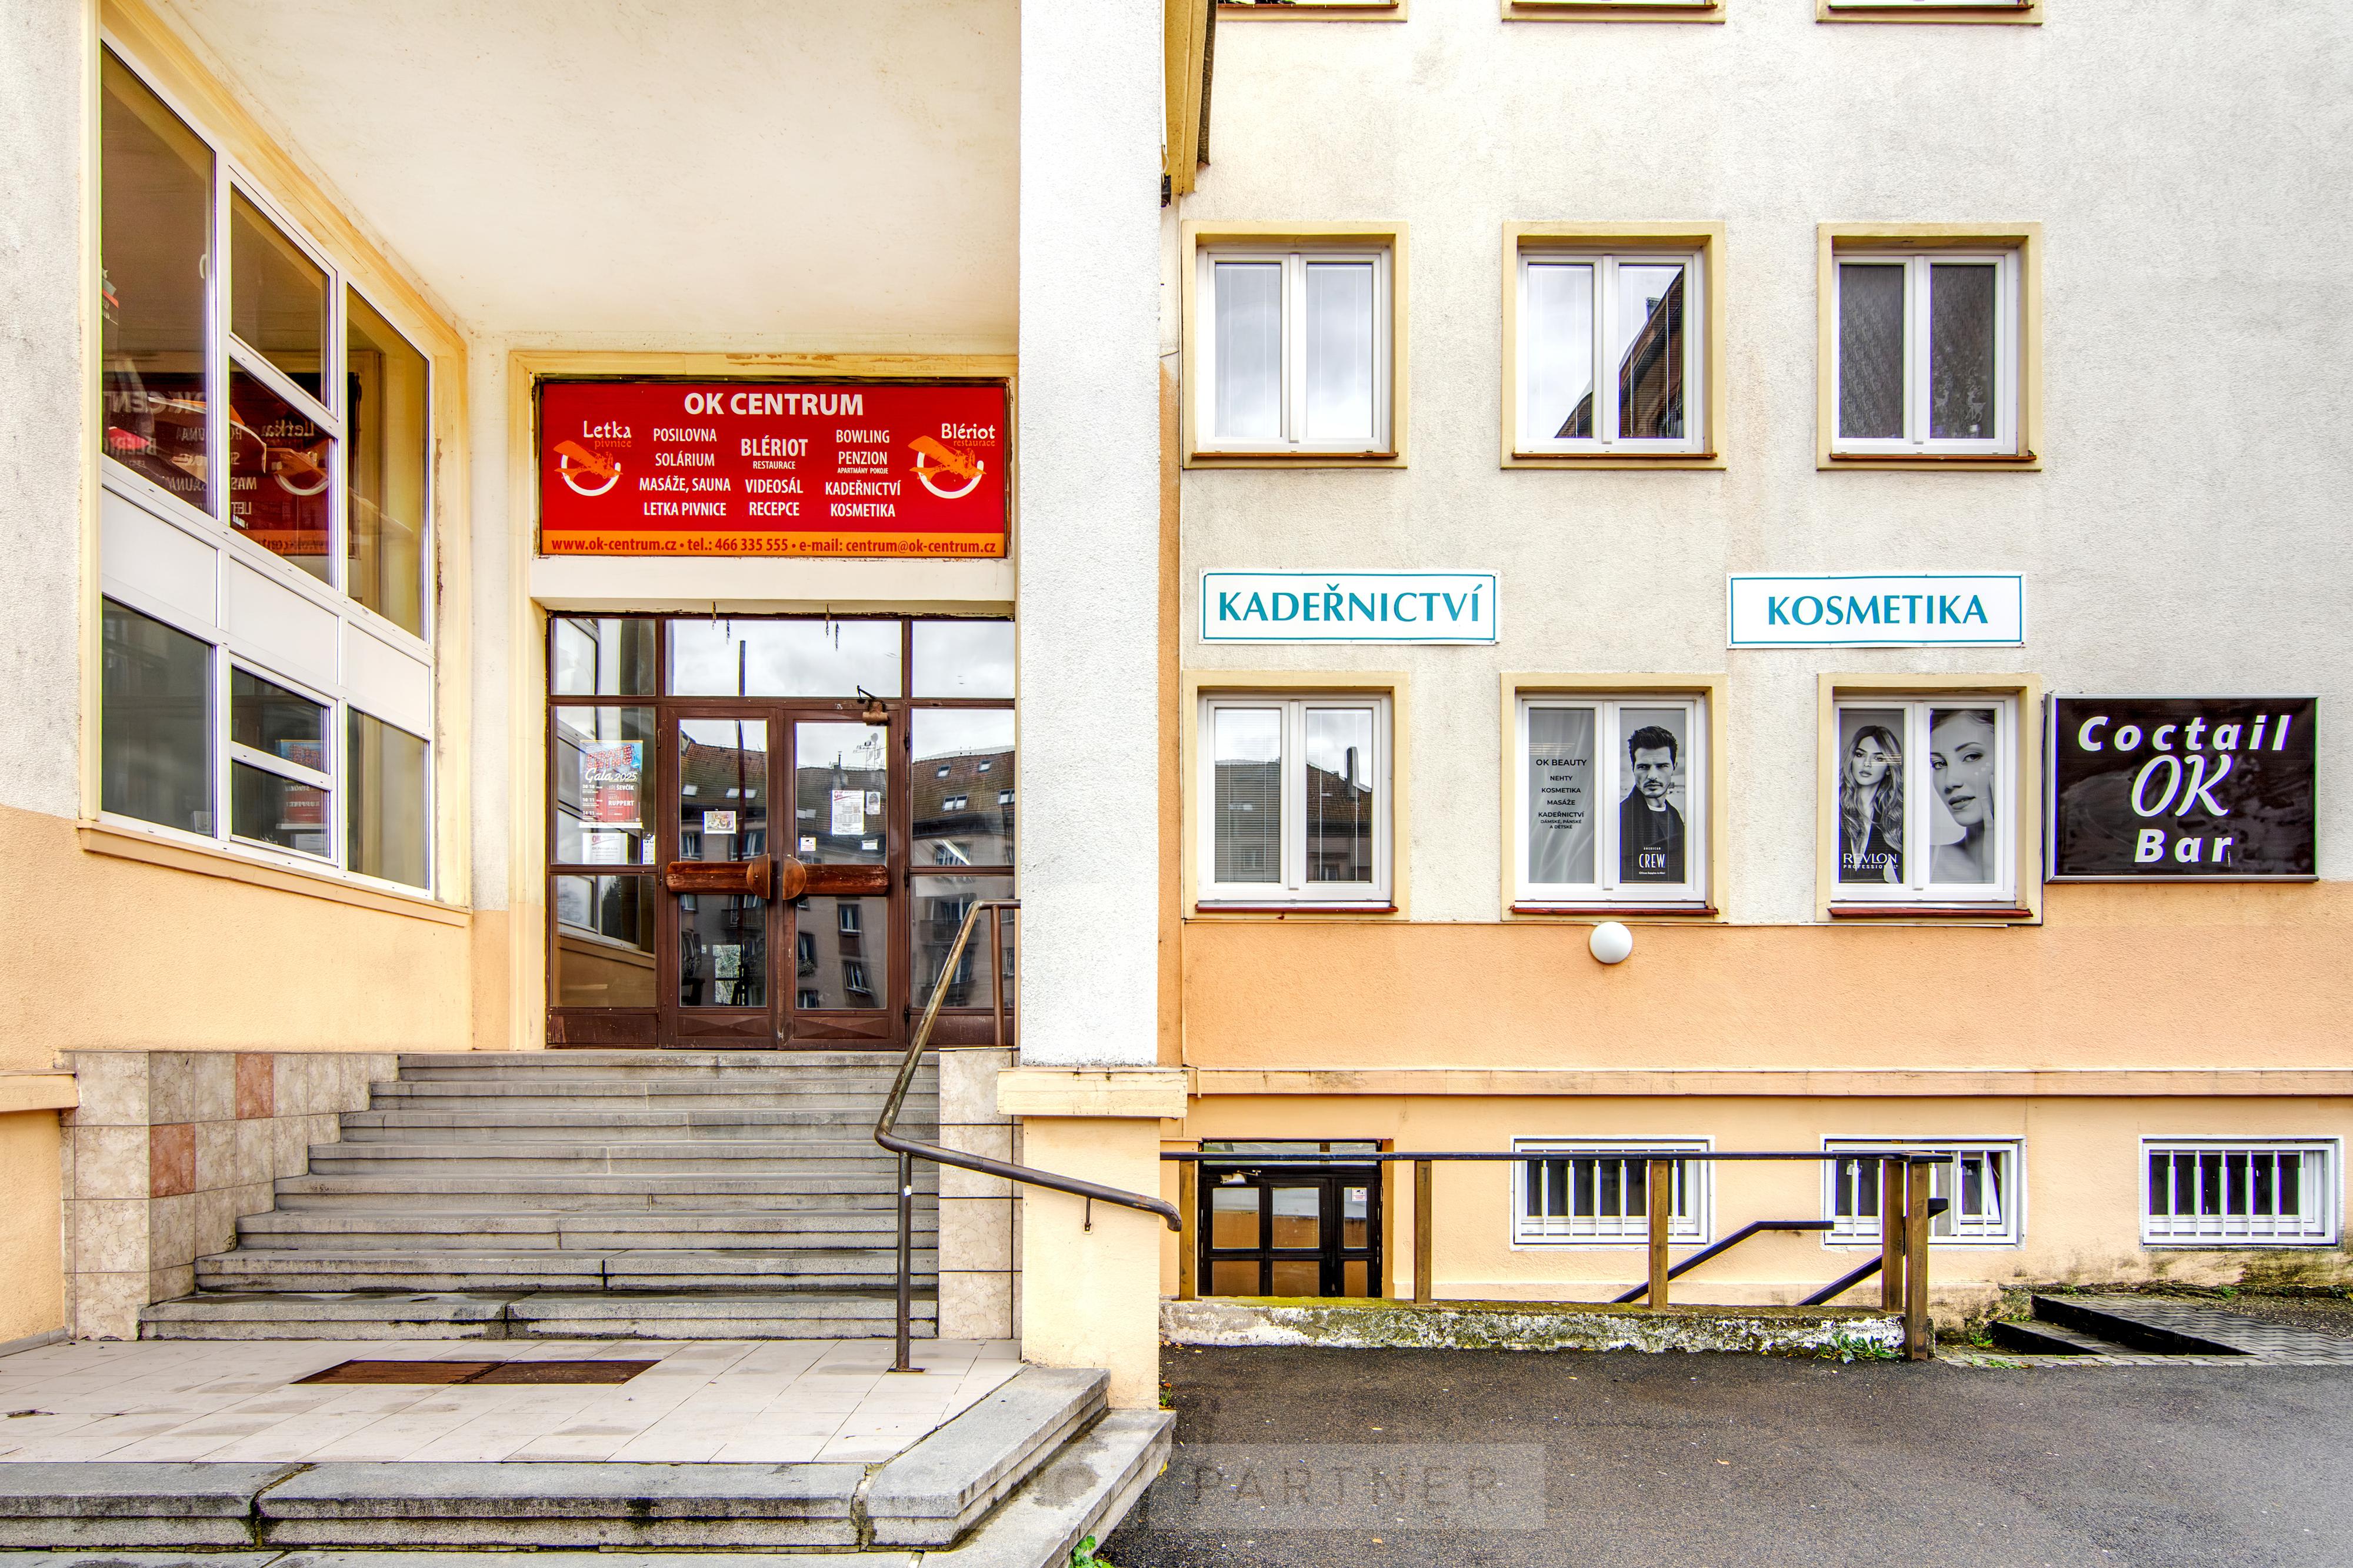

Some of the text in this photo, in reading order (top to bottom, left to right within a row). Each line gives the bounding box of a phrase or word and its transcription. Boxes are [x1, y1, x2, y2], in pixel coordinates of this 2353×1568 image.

[684, 392, 863, 415] OK CENTRUM
[584, 421, 632, 439] Letka
[654, 428, 717, 442] POSILOVNA
[836, 429, 889, 443] BOWLING
[941, 423, 995, 439] Blériot
[594, 438, 632, 449] pivnice
[741, 435, 808, 456] BLÉRIOT
[953, 438, 995, 446] restaurace
[655, 451, 714, 466] SOLÁRIUM
[753, 461, 796, 469] RESTAURACE
[838, 451, 887, 465] PENZION
[639, 475, 731, 493] MASÁŽE, SAUNA
[745, 476, 804, 493] VIDEOSÁL
[825, 479, 901, 496] KADEŘNICTVÍ
[644, 502, 726, 516] LETKA PIVNICE
[749, 502, 799, 516] RECEPCE
[831, 503, 895, 517] KOSMETIKA
[551, 538, 996, 554] www.ok-centrum.cz tel.: 466 335 555 e-mail: centrum@ok-centrum.cz
[1219, 583, 1483, 622] KADEŘNICTVÍ
[1768, 595, 1989, 626] KOSMETIKA
[2078, 715, 2292, 752] Coctail
[585, 767, 638, 783] Gala 2025
[2131, 754, 2234, 817] OK
[2134, 828, 2234, 863] Bar
[1638, 853, 1665, 868] CREW
[1843, 853, 1897, 863] REVLON
